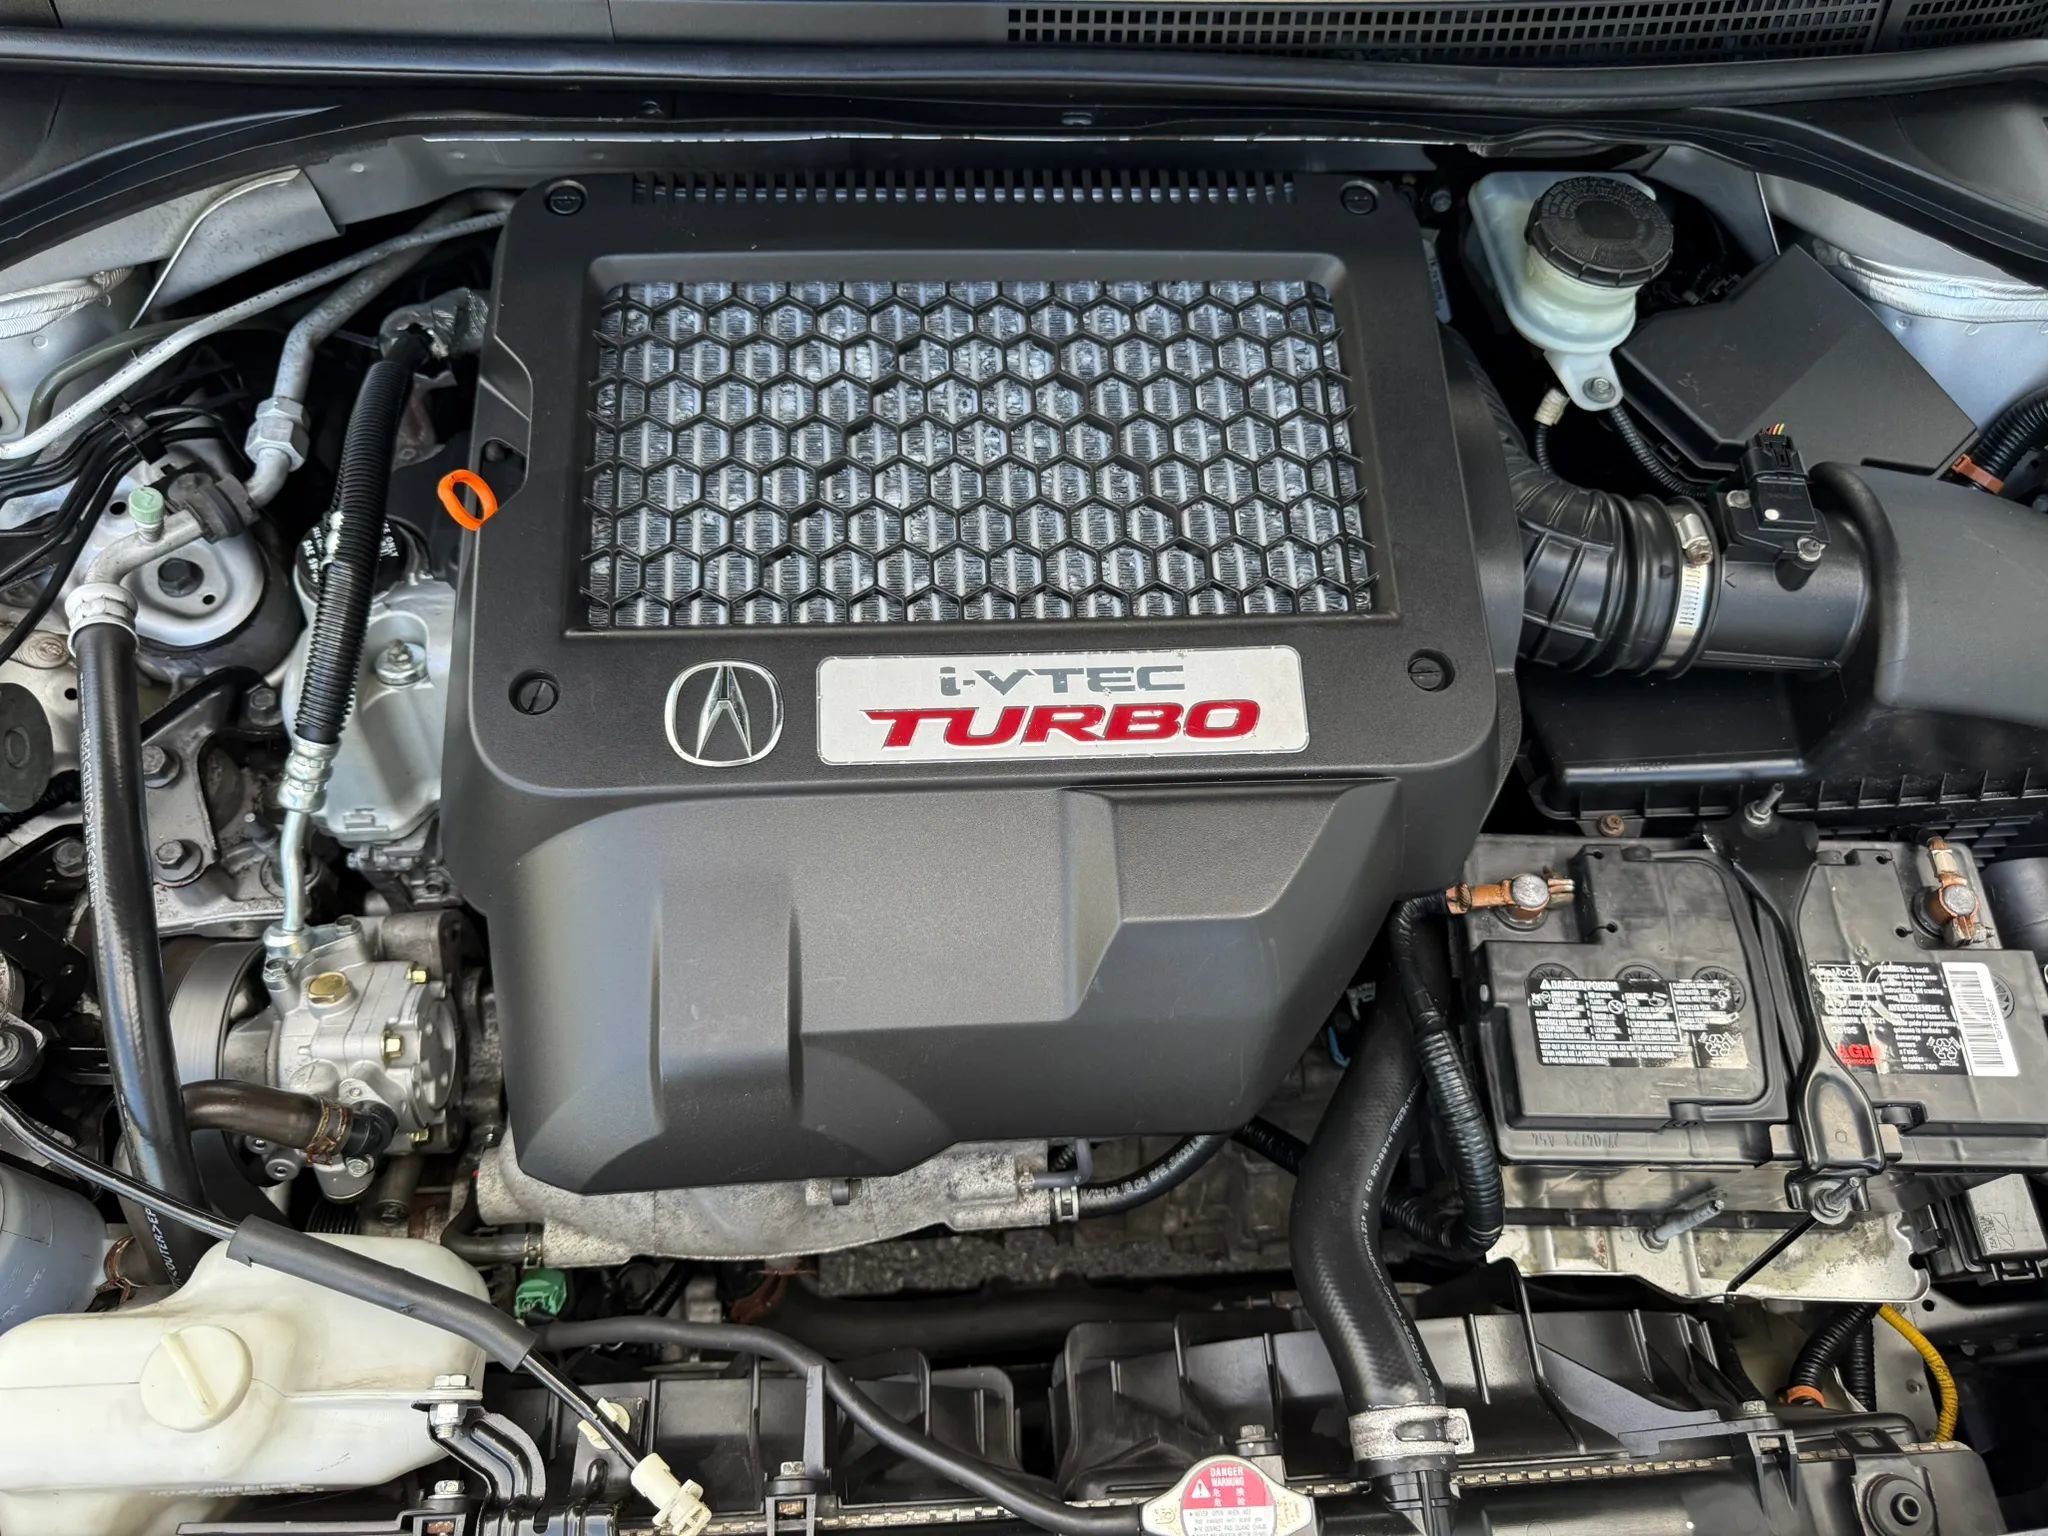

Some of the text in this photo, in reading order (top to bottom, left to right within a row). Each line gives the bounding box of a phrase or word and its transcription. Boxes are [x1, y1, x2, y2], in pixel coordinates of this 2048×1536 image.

[941, 665, 1185, 697] i-VTEC
[863, 699, 1260, 751] TURBO
[1551, 980, 1619, 990] DANGER/POISON
[1210, 1467, 1244, 1477] DANGER
